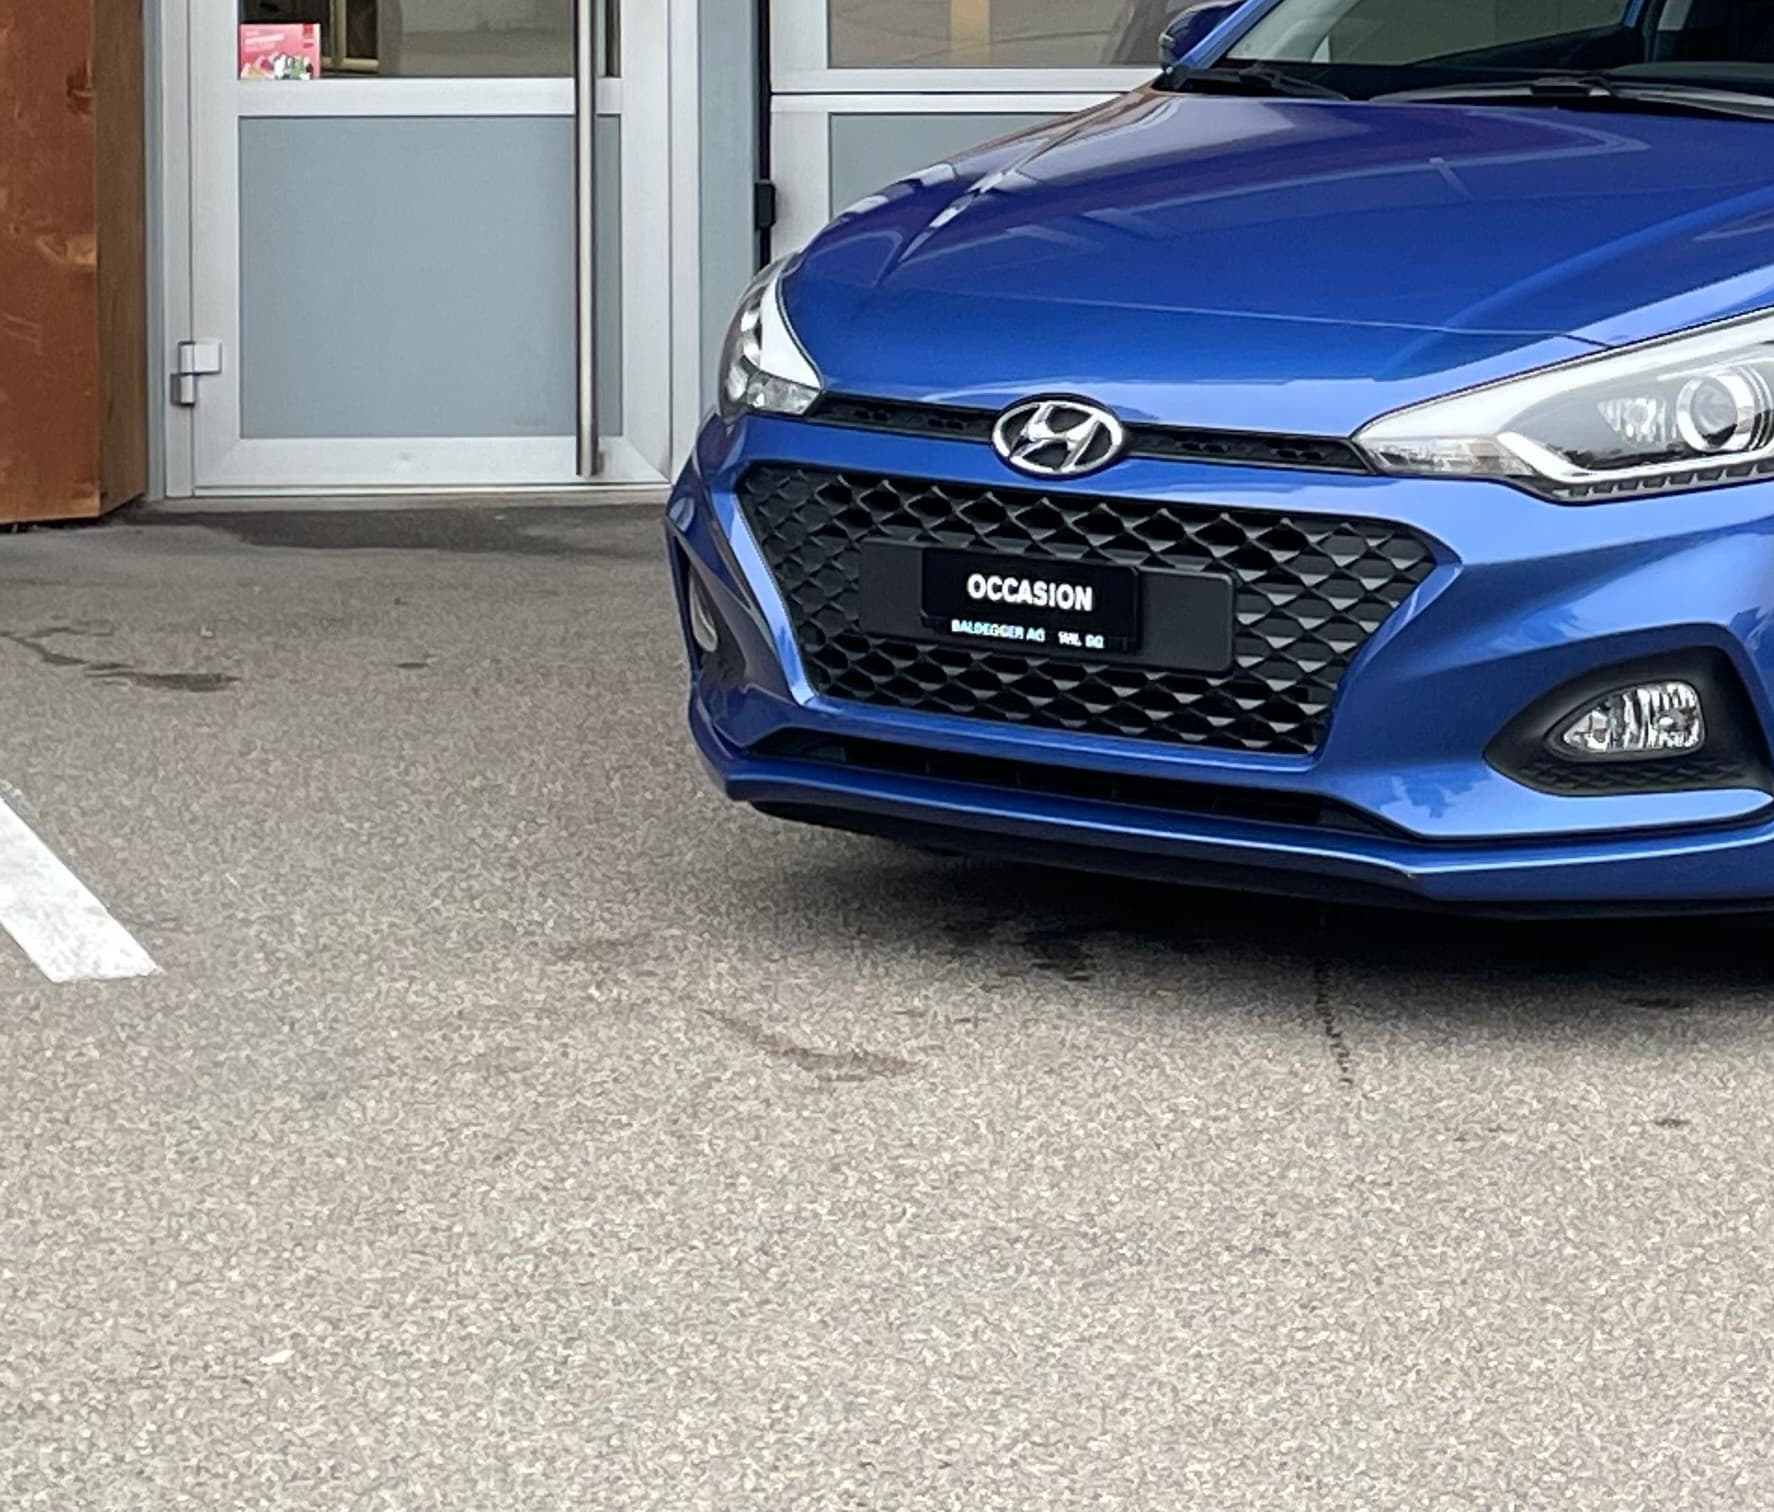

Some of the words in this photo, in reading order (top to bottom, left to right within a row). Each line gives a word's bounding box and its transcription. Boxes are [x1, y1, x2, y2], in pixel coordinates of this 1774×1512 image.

[967, 573, 1093, 612] OCCASION
[951, 619, 1024, 640] BALDEGGER
[1026, 627, 1046, 643] AG
